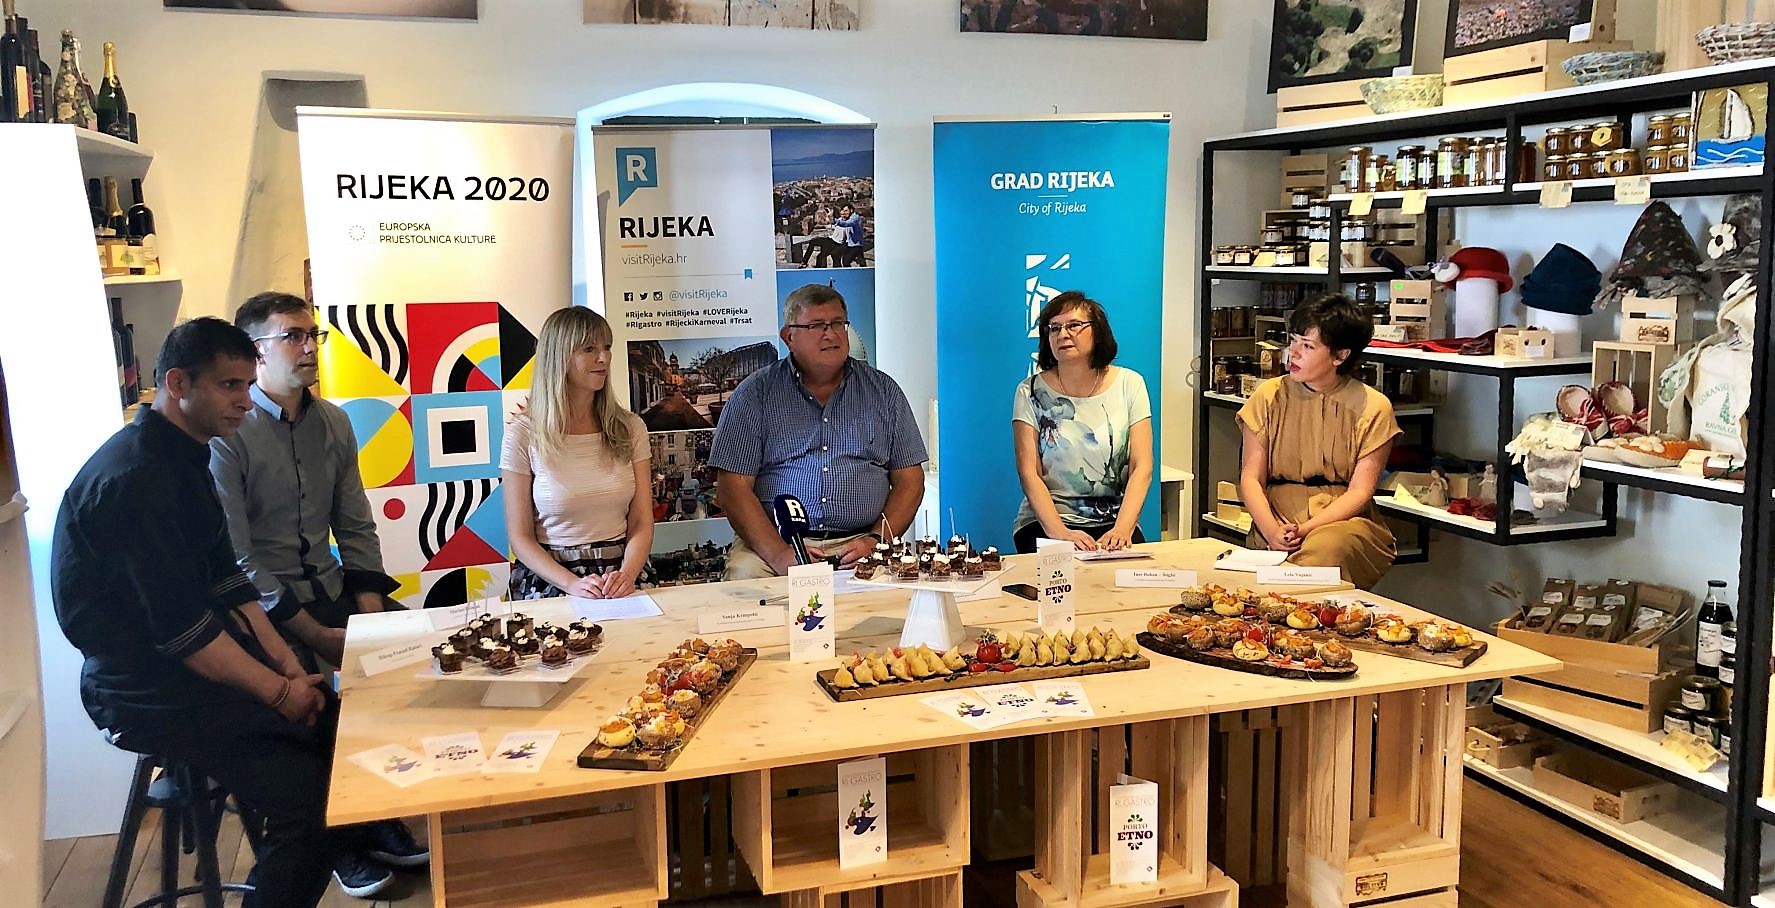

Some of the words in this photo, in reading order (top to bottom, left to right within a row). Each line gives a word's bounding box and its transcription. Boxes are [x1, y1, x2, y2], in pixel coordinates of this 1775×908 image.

[626, 154, 648, 182] R
[337, 173, 455, 200] RIJEKA
[464, 176, 550, 201] 2020
[990, 172, 1044, 190] GRAD
[1047, 171, 1115, 192] RIJEKA
[1019, 203, 1039, 216] City
[1041, 202, 1052, 216] of
[1054, 202, 1087, 215] Rijeka
[379, 222, 431, 231] EUROPSKA
[619, 215, 715, 239] RIJEKA
[379, 235, 452, 244] PRIJESTOLNICA
[454, 235, 497, 244] KULTURE
[622, 253, 688, 267] visitRijeka.hr
[669, 289, 728, 302] @visitRijeka
[625, 311, 653, 320] #Rijeka
[656, 309, 700, 318] #visitRijeka
[702, 307, 748, 318] #LOVERijeka
[626, 320, 662, 330] #RIgastro
[729, 316, 752, 326] #Trsat
[1045, 584, 1072, 596] ETNO
[1117, 831, 1154, 841] ETNO
